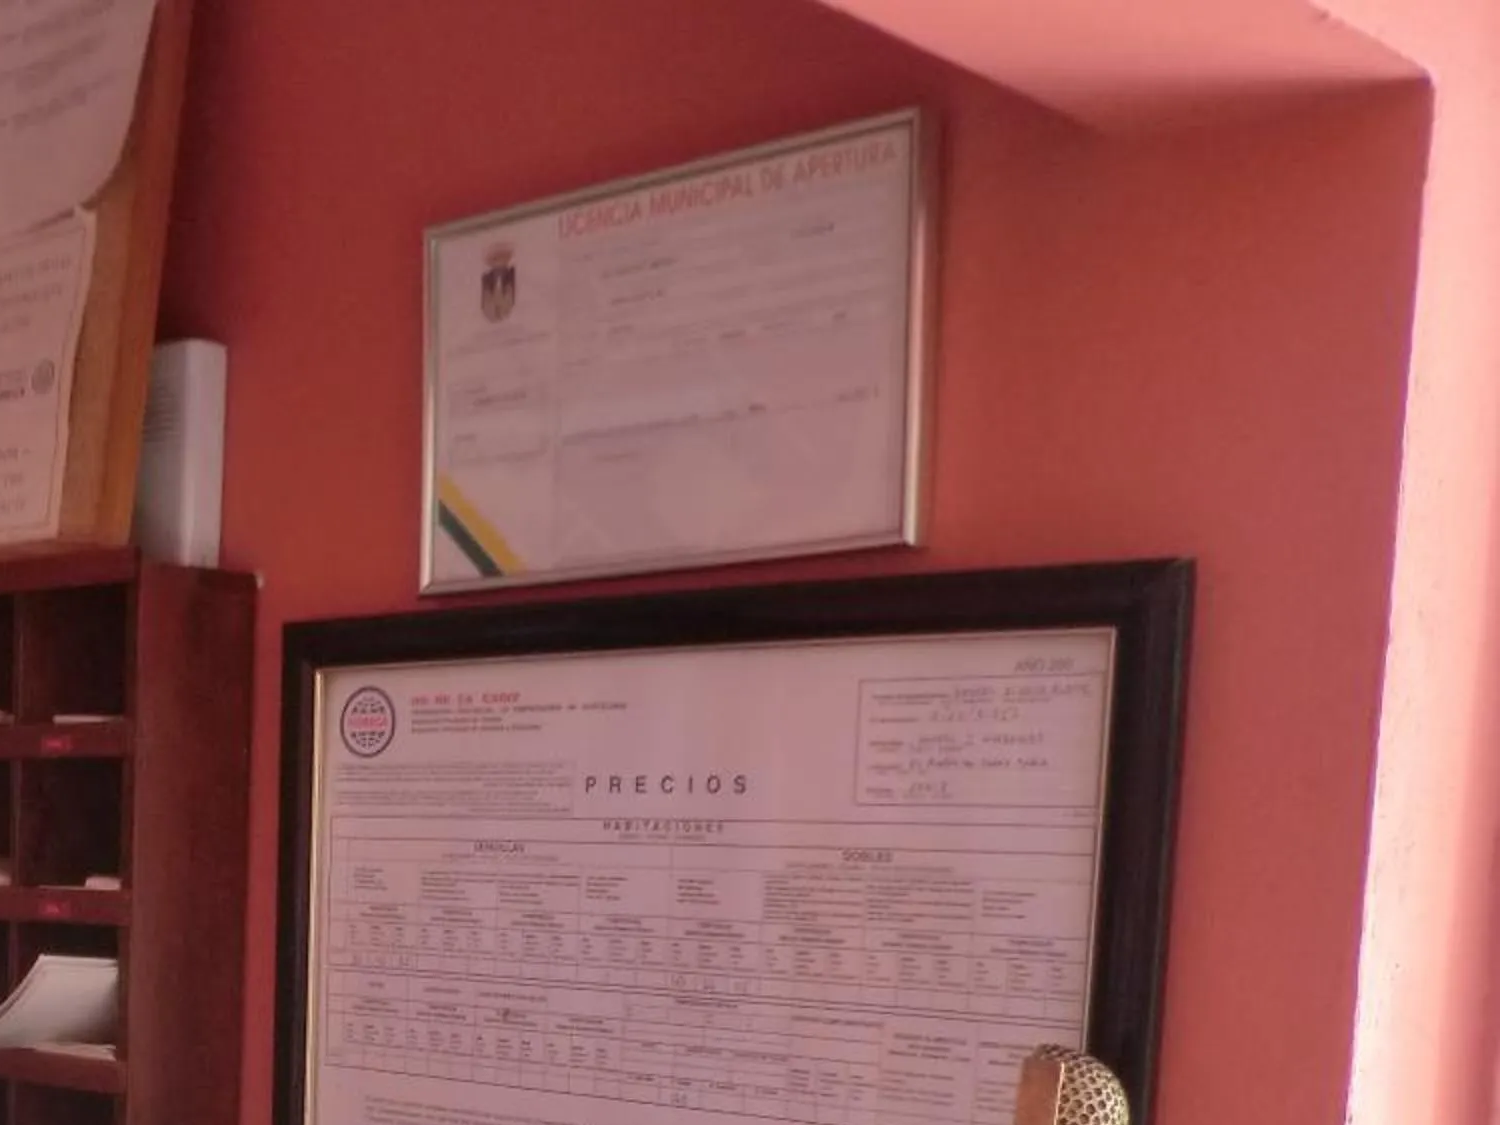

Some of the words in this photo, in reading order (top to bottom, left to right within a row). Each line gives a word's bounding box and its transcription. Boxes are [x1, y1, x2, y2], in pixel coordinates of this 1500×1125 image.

[649, 174, 754, 217] MUNICIPAL
[759, 166, 786, 192] DE
[793, 142, 897, 184] APERTURA
[585, 775, 747, 794] PRECIOS
[602, 820, 724, 833] HABITACIONES
